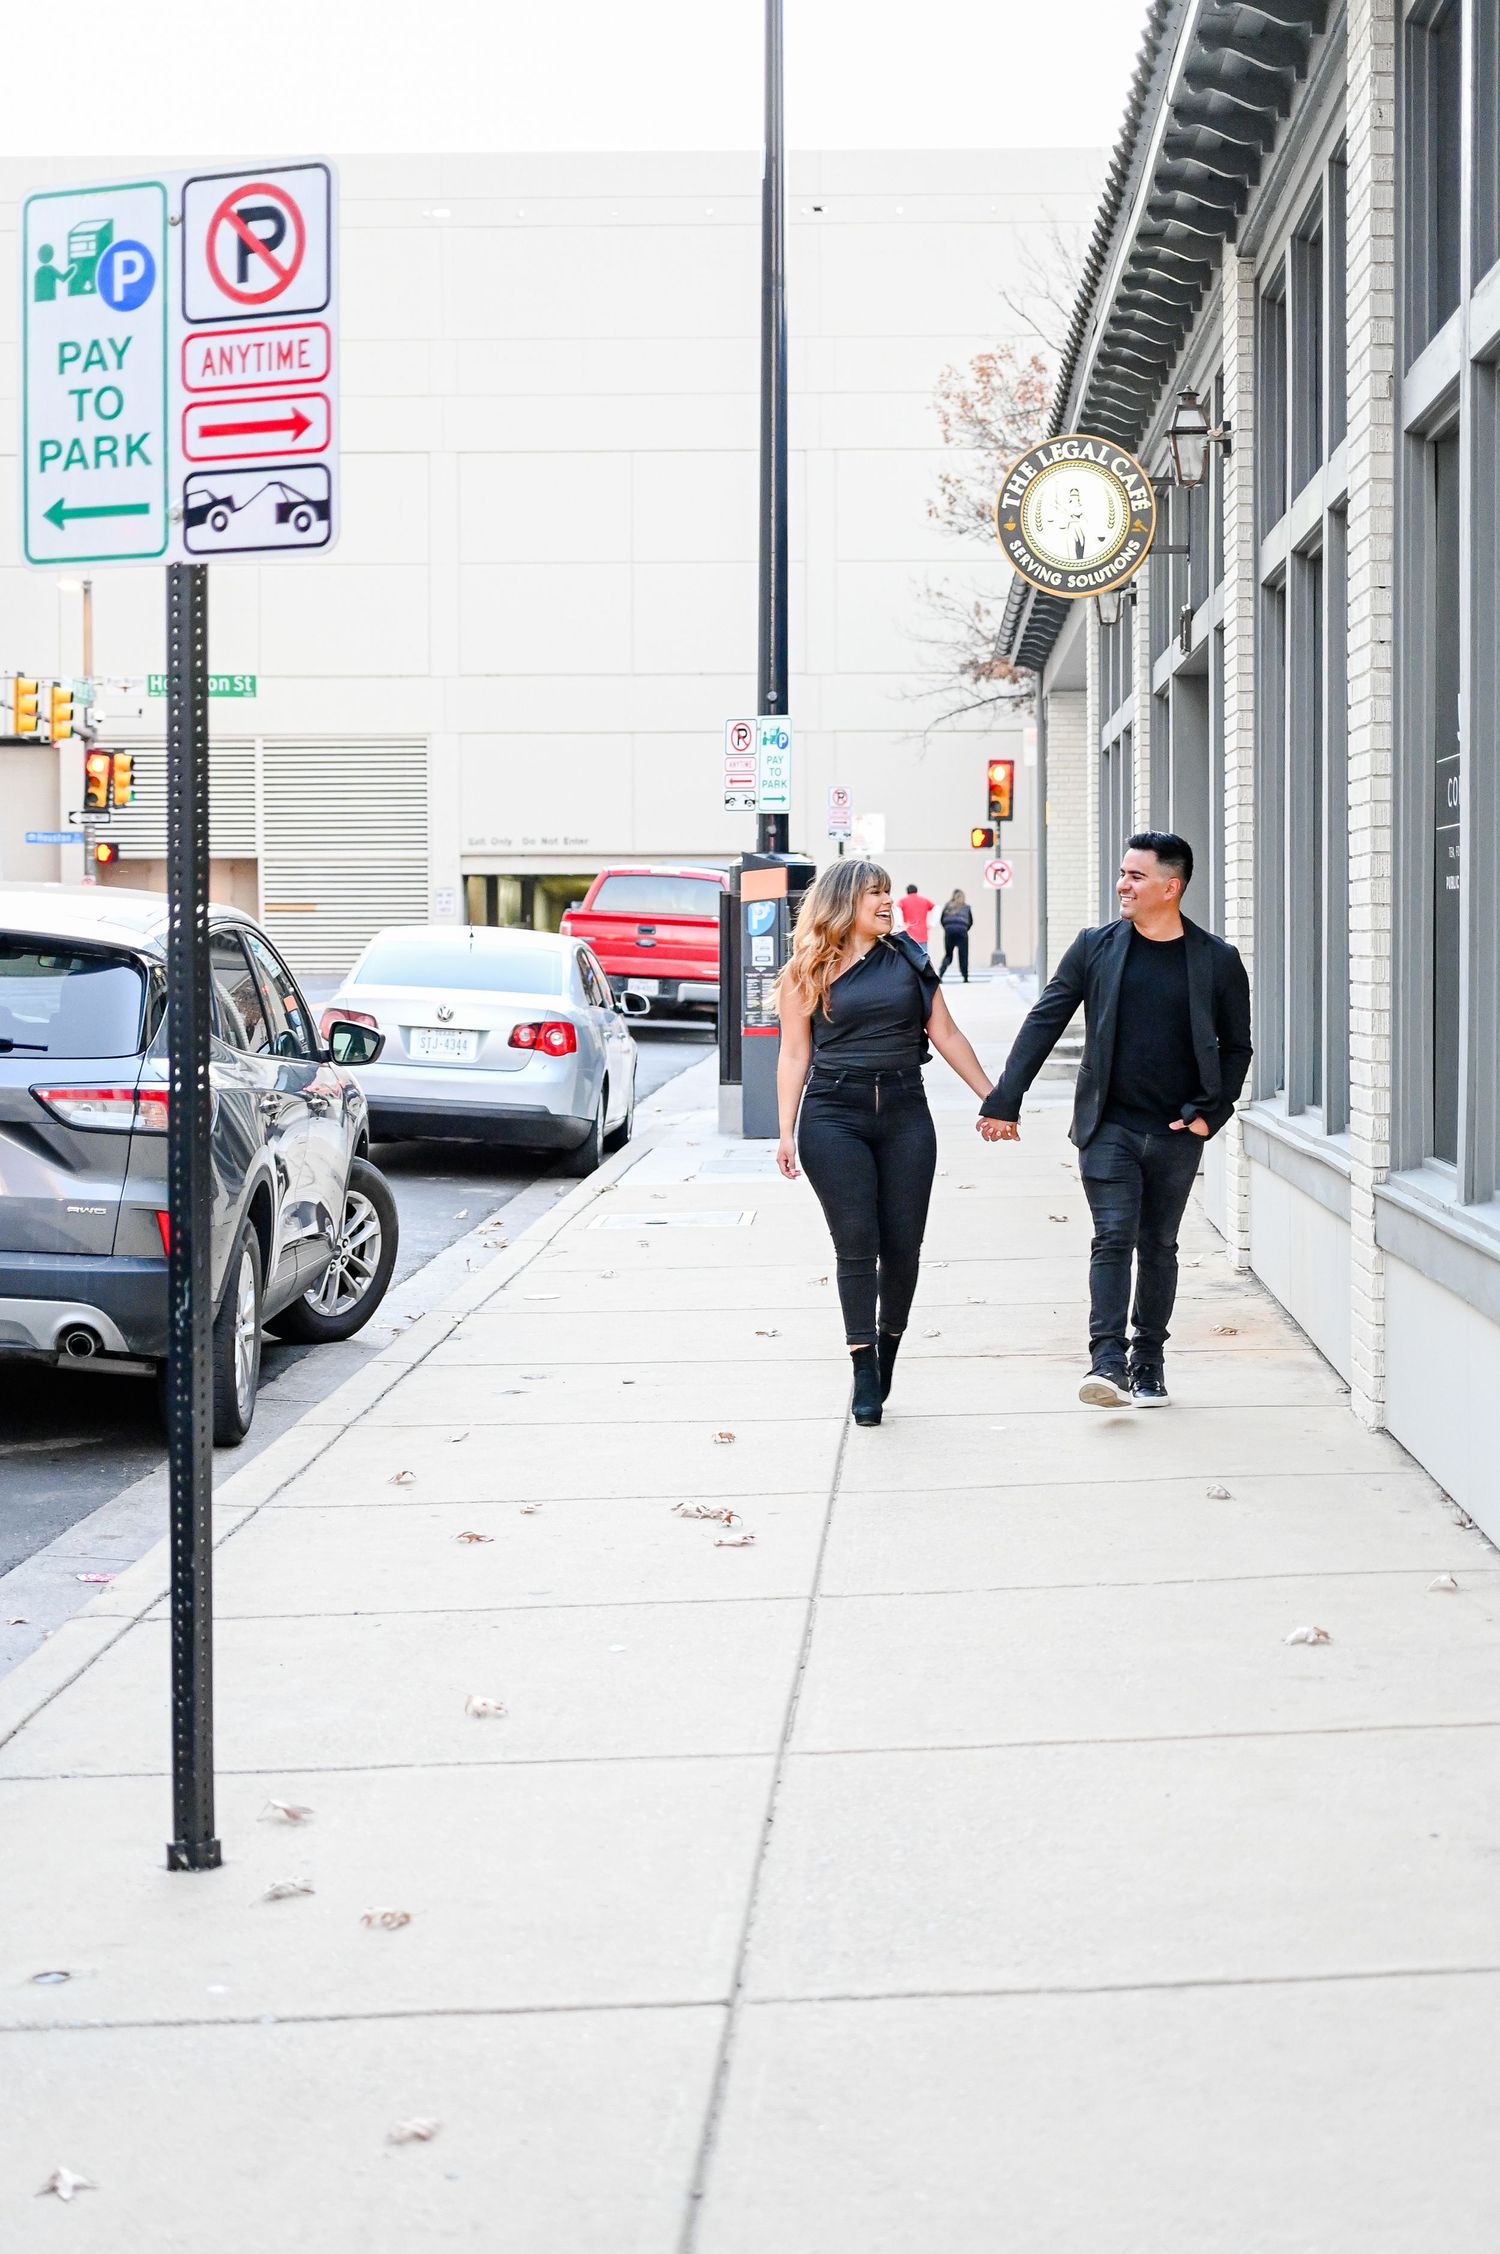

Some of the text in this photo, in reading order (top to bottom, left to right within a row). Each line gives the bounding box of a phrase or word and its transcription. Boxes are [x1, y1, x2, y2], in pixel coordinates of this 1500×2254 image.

[57, 336, 134, 375] PAY
[201, 338, 312, 377] ANYTIME
[68, 386, 125, 422] TO
[38, 432, 153, 473] PARK
[1001, 461, 1039, 509] THE
[1035, 440, 1111, 469] LEGAL
[1009, 539, 1141, 588] SERVING SOLUTIONS
[233, 676, 253, 692] St
[767, 755, 784, 765] PAY
[769, 767, 782, 777] TO
[762, 779, 788, 789] PARK
